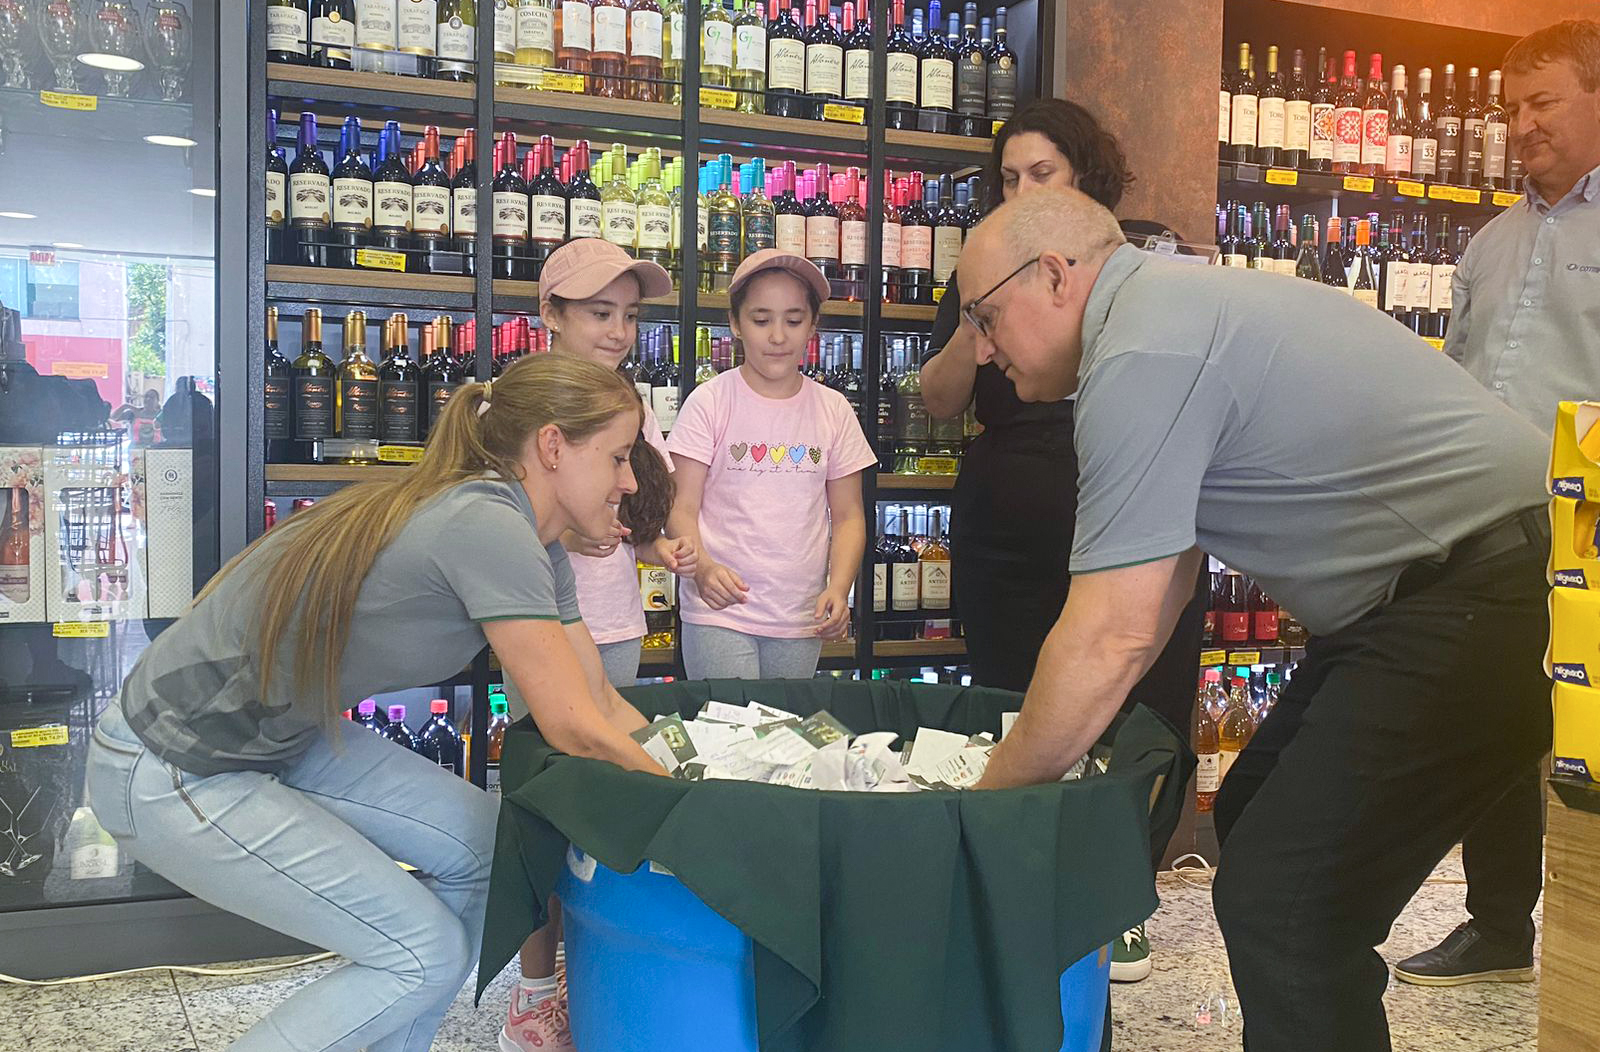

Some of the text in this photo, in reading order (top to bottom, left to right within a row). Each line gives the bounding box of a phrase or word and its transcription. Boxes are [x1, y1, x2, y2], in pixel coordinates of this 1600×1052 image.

[1446, 126, 1457, 136] 33
[1399, 144, 1409, 154] 33
[1424, 148, 1435, 158] 33
[293, 179, 328, 187] RESERVADO
[336, 185, 370, 193] RESERVADO
[378, 188, 411, 196] RESERVADO
[749, 463, 766, 477] day
[649, 570, 666, 578] Gato
